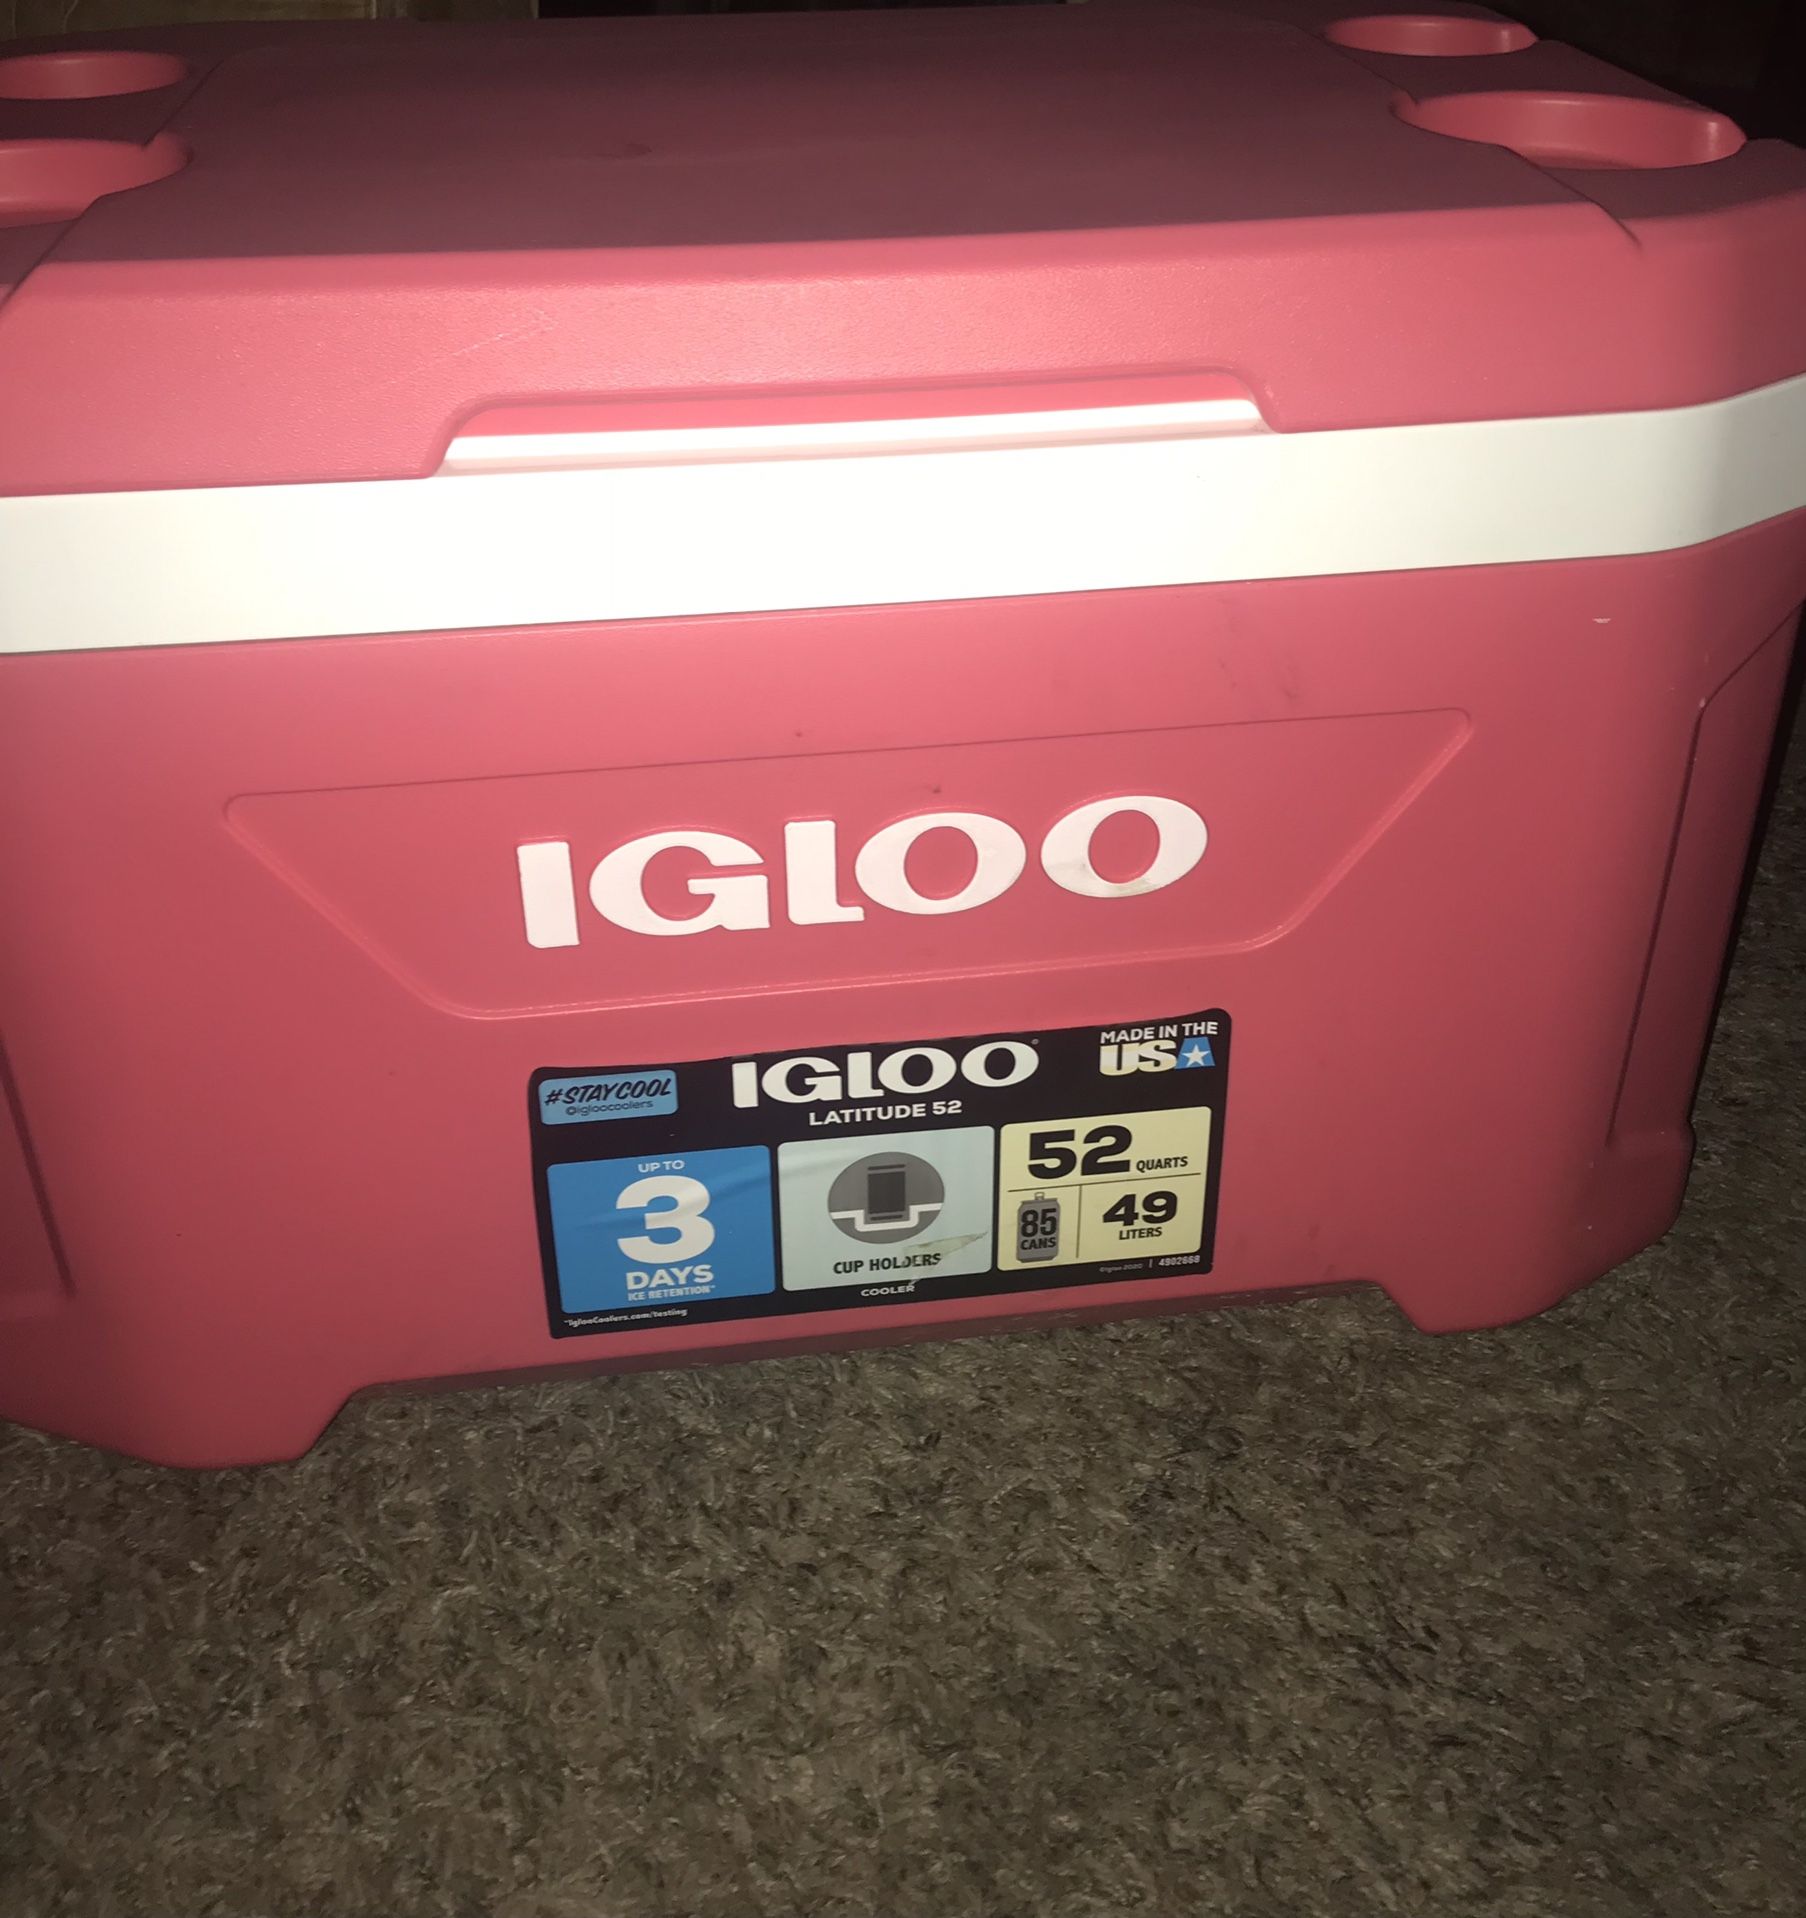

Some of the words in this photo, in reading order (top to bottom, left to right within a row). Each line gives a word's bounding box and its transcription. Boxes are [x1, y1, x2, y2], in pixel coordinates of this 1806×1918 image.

[517, 795, 1208, 949] IGLOO
[1100, 1027, 1155, 1044] MADE
[1158, 1024, 1178, 1038] IN
[1182, 1021, 1218, 1036] THE
[1099, 1036, 1216, 1076] USA
[732, 1041, 1039, 1108] IGLOO
[544, 1078, 672, 1106] #STAYCOOL
[565, 1100, 654, 1116] @igloocoolers
[809, 1103, 926, 1126] LATITUDE
[932, 1100, 963, 1115] 52
[1028, 1125, 1132, 1180] 52
[1136, 1156, 1188, 1173] QUARTS
[638, 1163, 660, 1173] UP
[663, 1160, 685, 1170] TO
[615, 1175, 715, 1264] 3
[1103, 1190, 1178, 1227] 49
[1020, 1208, 1057, 1238] 85
[1119, 1227, 1162, 1241] LITERS
[1020, 1237, 1056, 1251] CANS
[833, 1260, 864, 1274] CUP
[869, 1253, 941, 1271] HOLDERS
[626, 1264, 714, 1290] DAYS
[628, 1291, 646, 1301] ICE
[861, 1285, 915, 1297] COOLER
